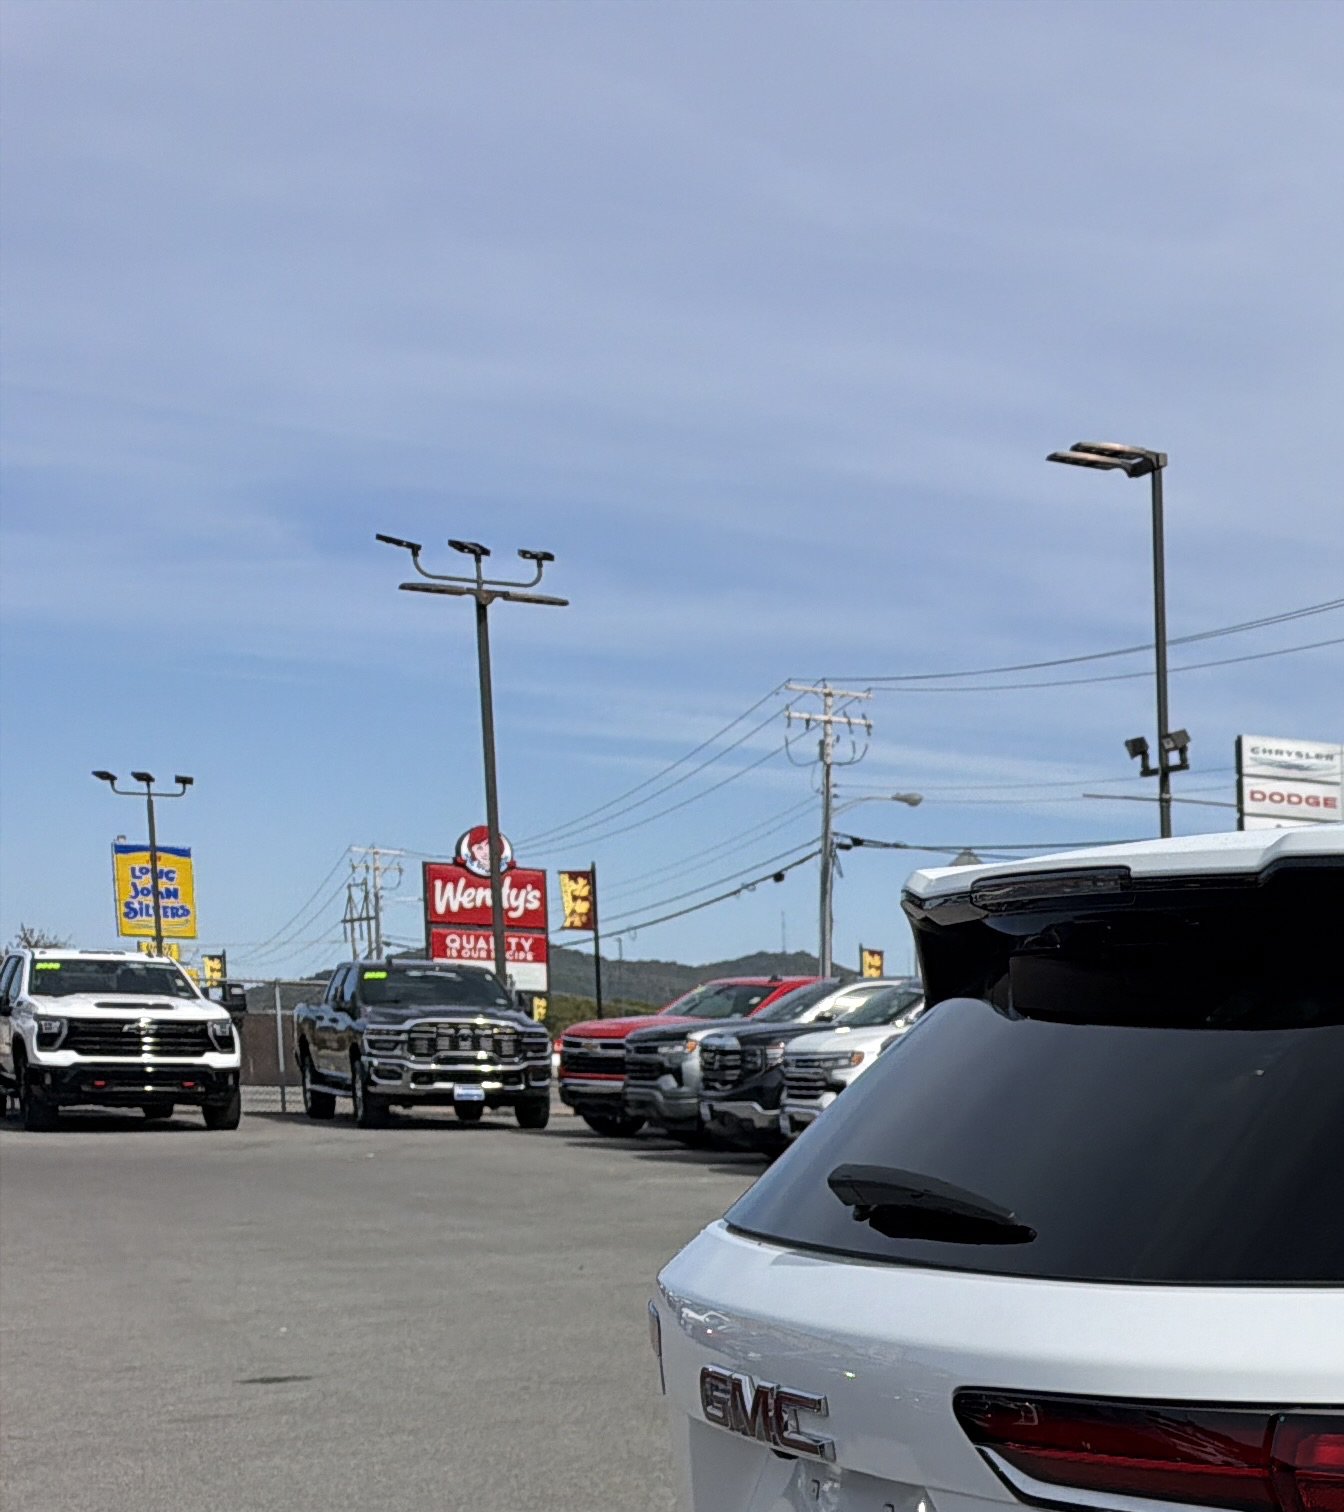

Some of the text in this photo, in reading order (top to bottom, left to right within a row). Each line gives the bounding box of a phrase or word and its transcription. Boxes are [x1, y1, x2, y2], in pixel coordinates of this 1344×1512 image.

[1249, 789, 1338, 809] DODGE
[445, 934, 533, 951] QUATY
[490, 951, 534, 961] CIPE
[701, 1363, 836, 1463] GMC
